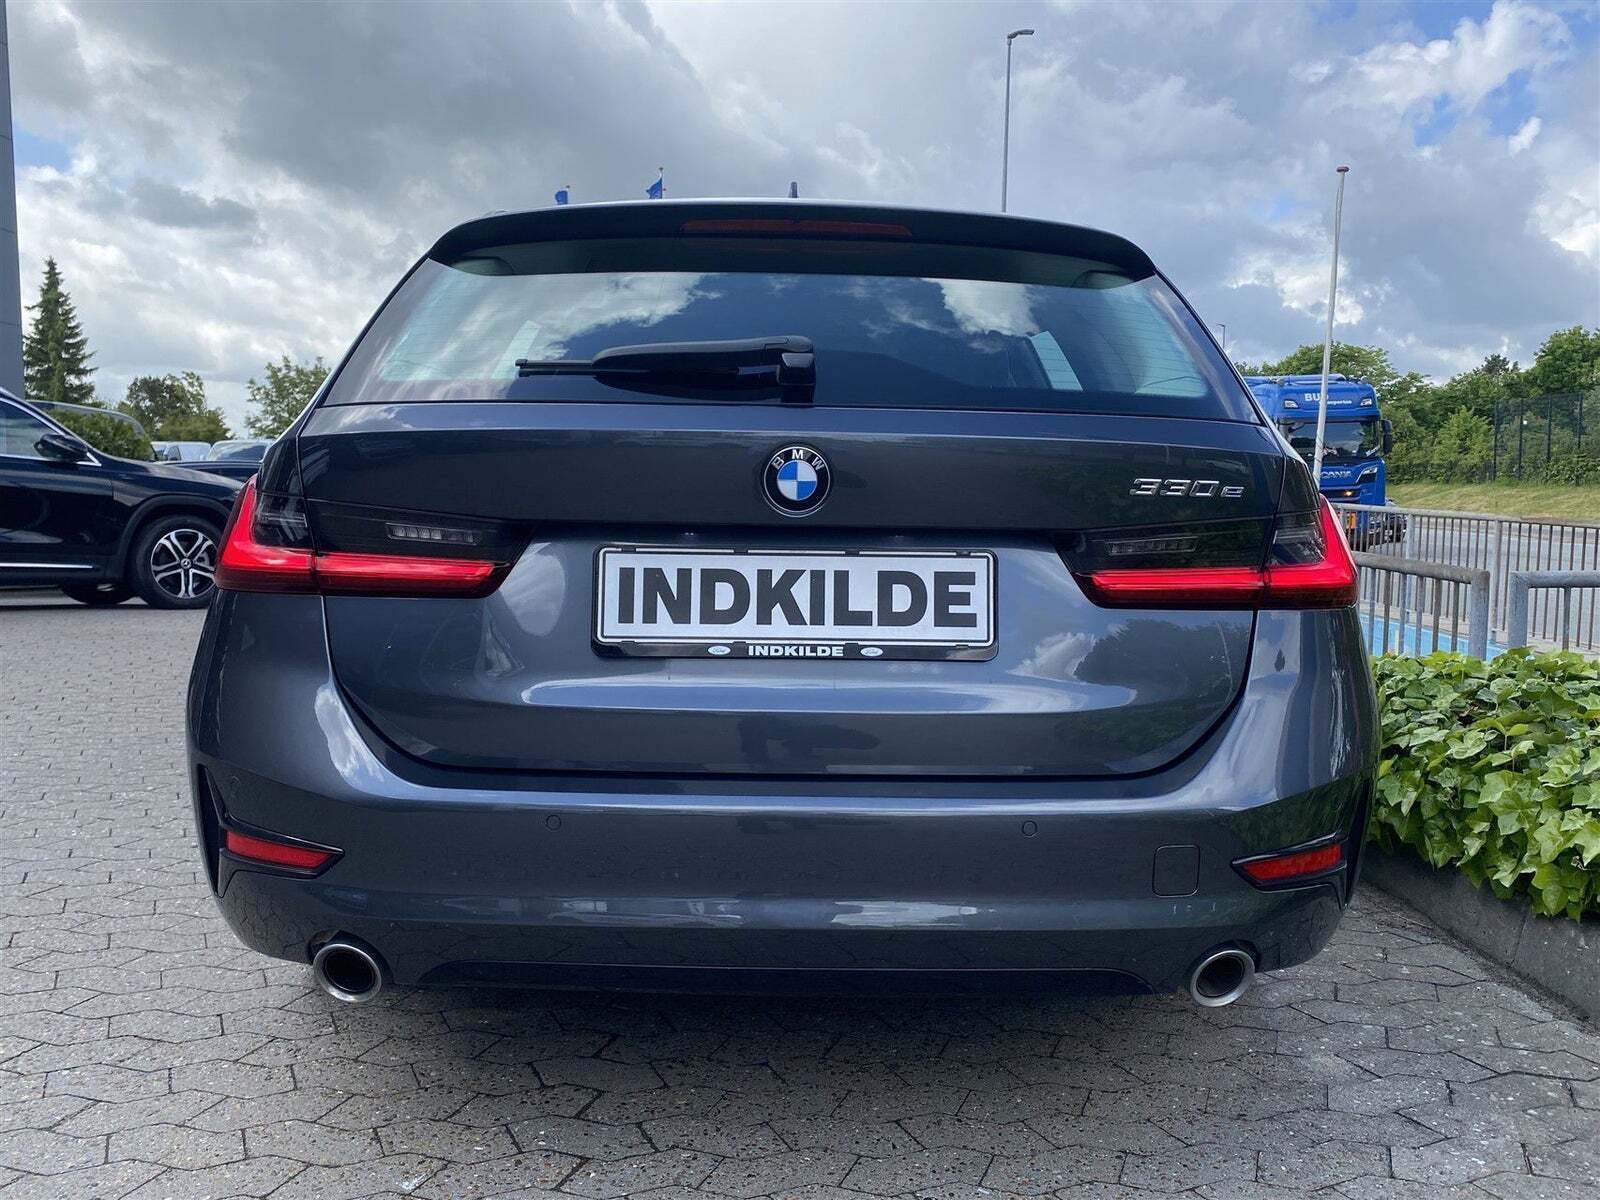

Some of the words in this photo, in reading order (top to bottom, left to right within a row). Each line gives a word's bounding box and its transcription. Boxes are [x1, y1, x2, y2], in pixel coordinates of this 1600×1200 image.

[771, 449, 824, 470] BMW
[1319, 471, 1352, 480] CANIA
[1129, 478, 1244, 498] 330e
[617, 567, 977, 628] INDKILDE
[748, 645, 844, 657] INDKILDE
